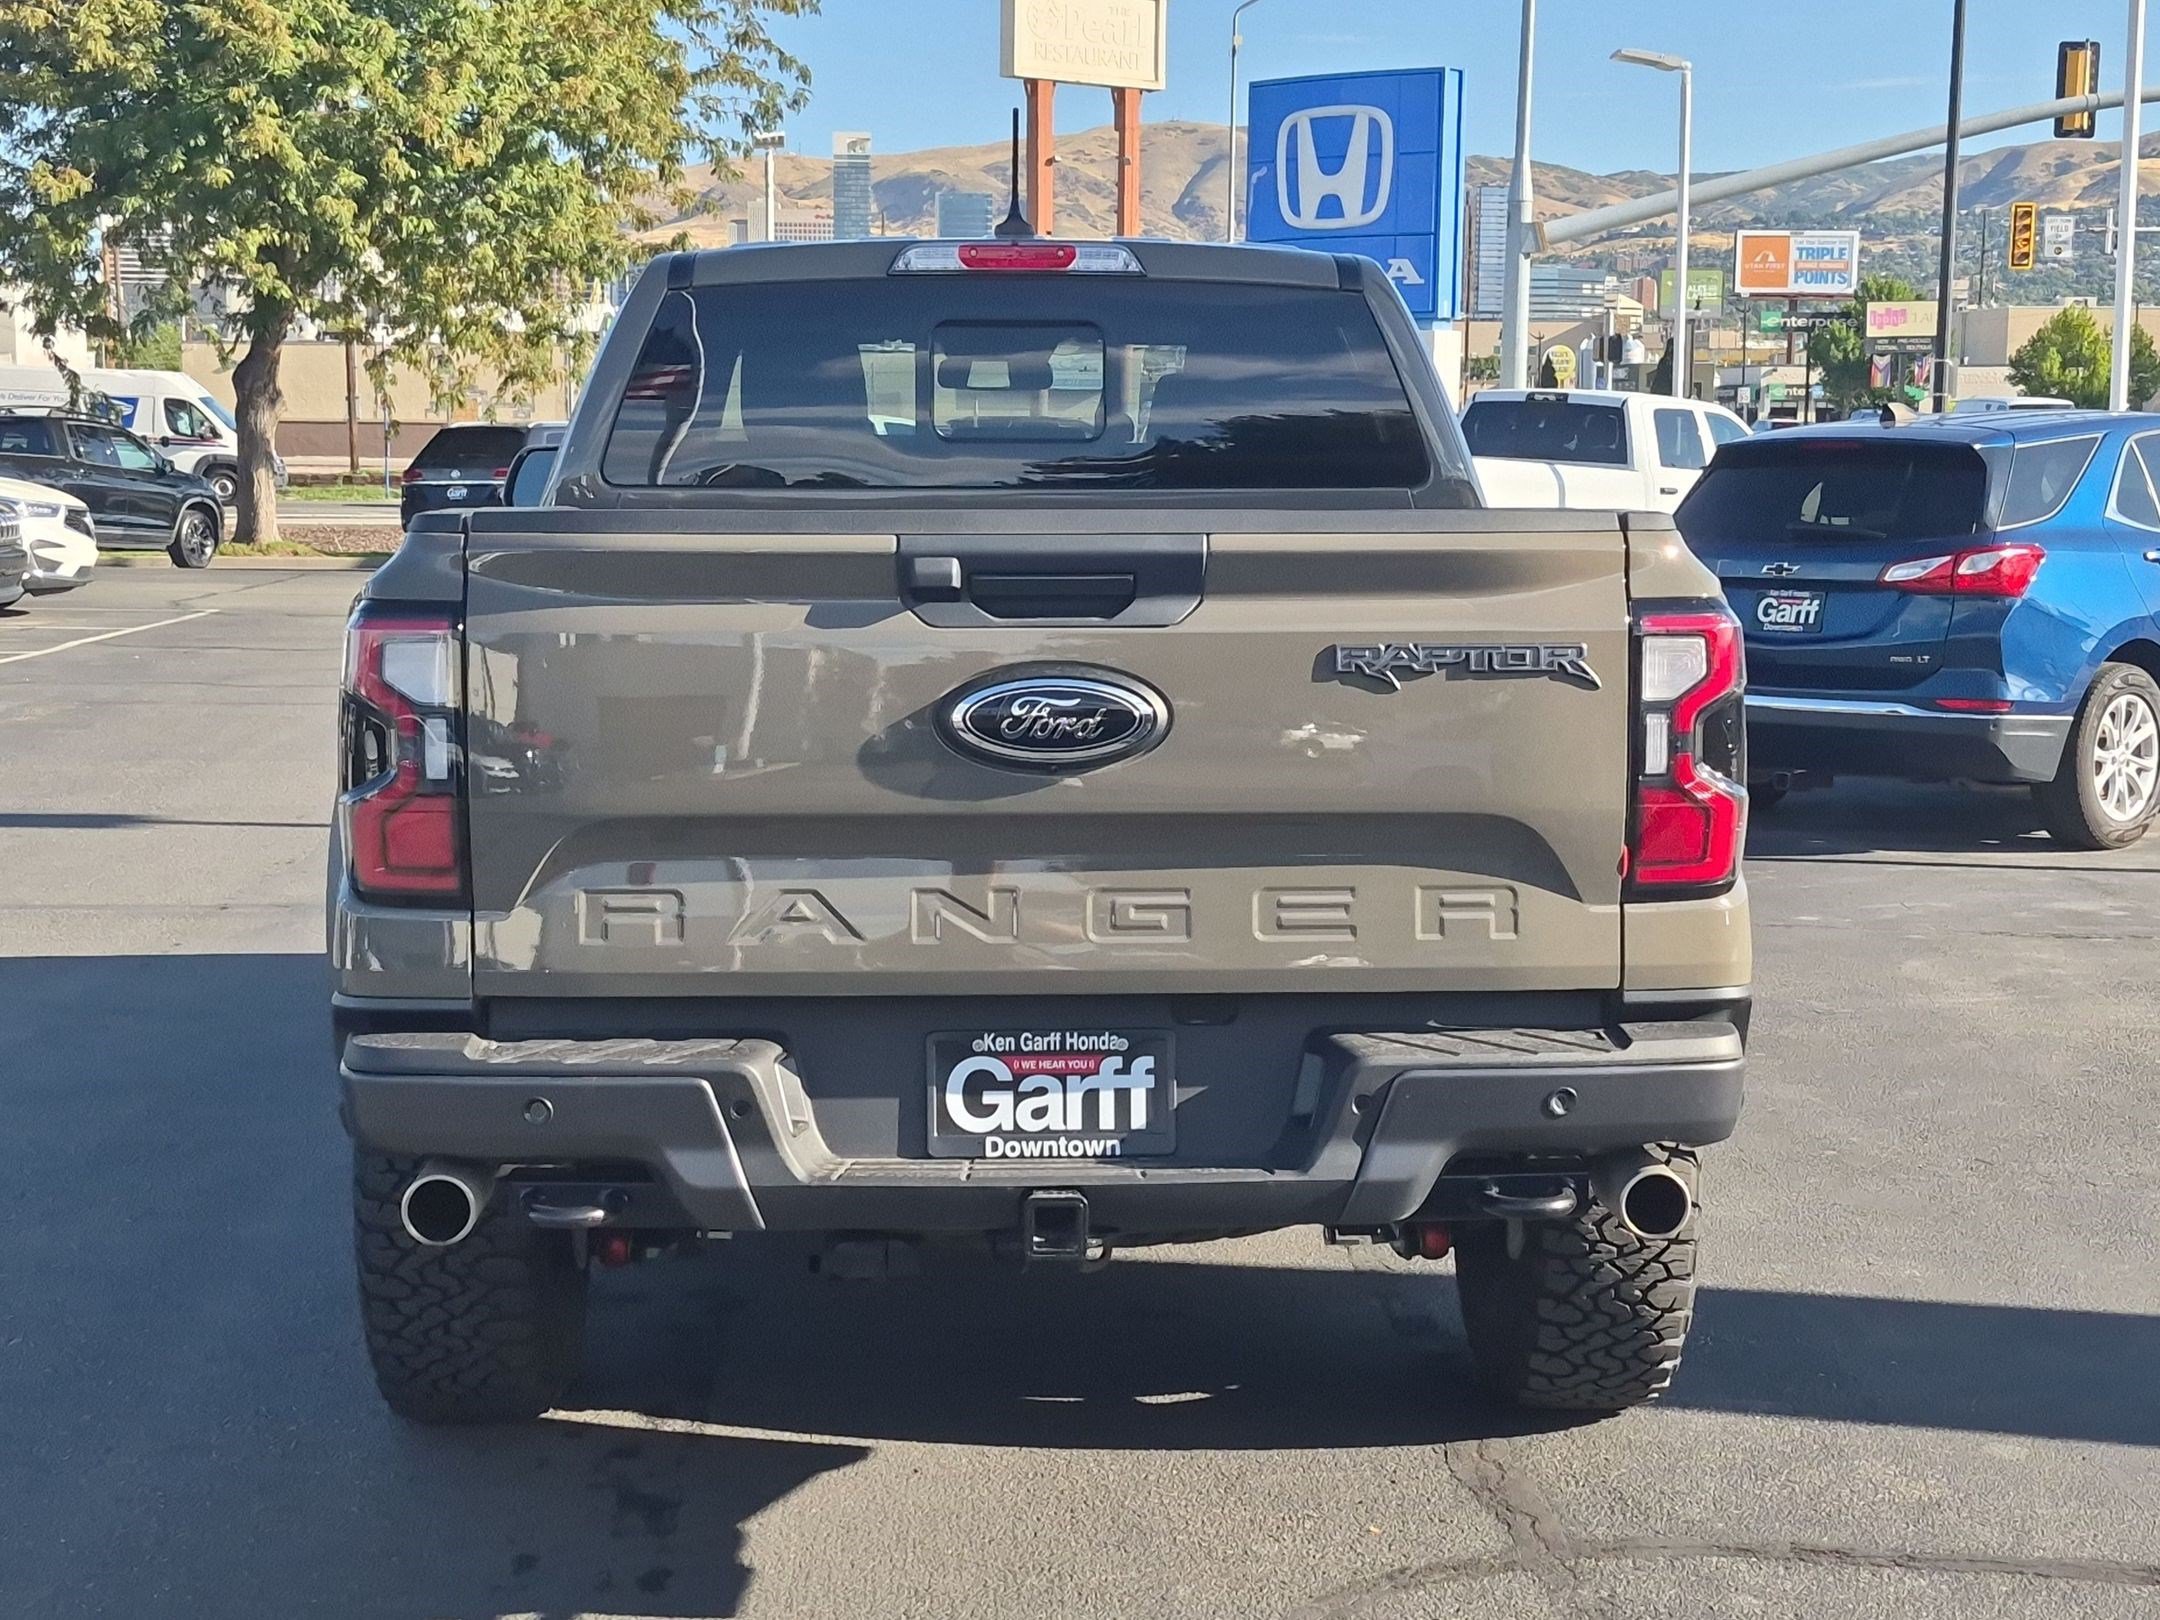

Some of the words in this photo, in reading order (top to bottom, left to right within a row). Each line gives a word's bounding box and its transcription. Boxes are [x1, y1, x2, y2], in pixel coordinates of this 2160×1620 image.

[1109, 6, 1131, 16] THE
[1034, 42, 1143, 70] RESTAURANT
[1796, 247, 1848, 260] TRIPLE
[1794, 271, 1848, 285] POINTS
[37, 393, 50, 402] For
[1757, 597, 1821, 624] Garff
[1336, 642, 1602, 690] RAPTOR
[1917, 655, 1932, 664] LT
[1000, 696, 1109, 740] Ford
[575, 885, 1520, 947] RANGER
[984, 1032, 1015, 1050] Ken
[1020, 1032, 1061, 1051] Garff
[1065, 1032, 1118, 1050] Honda
[1021, 1060, 1037, 1069] WE
[1039, 1060, 1065, 1069] HEAR
[1067, 1060, 1087, 1069] YOU
[945, 1055, 1155, 1133] Garff
[985, 1136, 1121, 1158] Downtown
